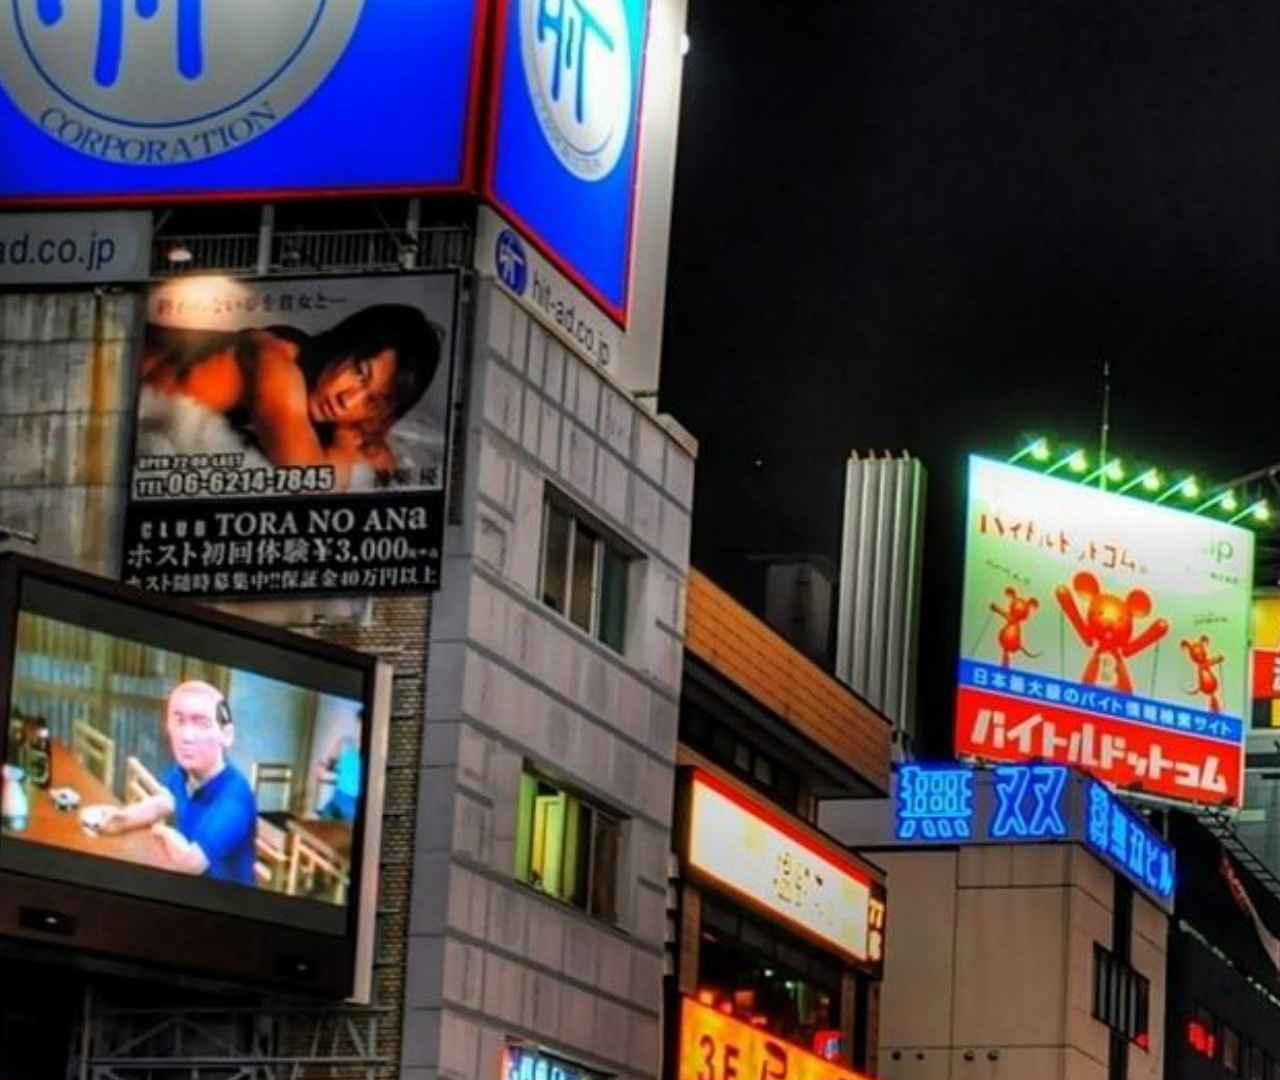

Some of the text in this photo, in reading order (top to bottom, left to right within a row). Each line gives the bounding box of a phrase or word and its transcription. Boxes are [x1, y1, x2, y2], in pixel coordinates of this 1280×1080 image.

[38, 99, 279, 166] CORPORATION
[530, 275, 611, 368] hit-ad.co.jp
[136, 465, 335, 496] TEL 06-6214-7845
[215, 511, 298, 537] TORA
[307, 508, 355, 534] NO
[970, 706, 1228, 794] バイトルドットコム
